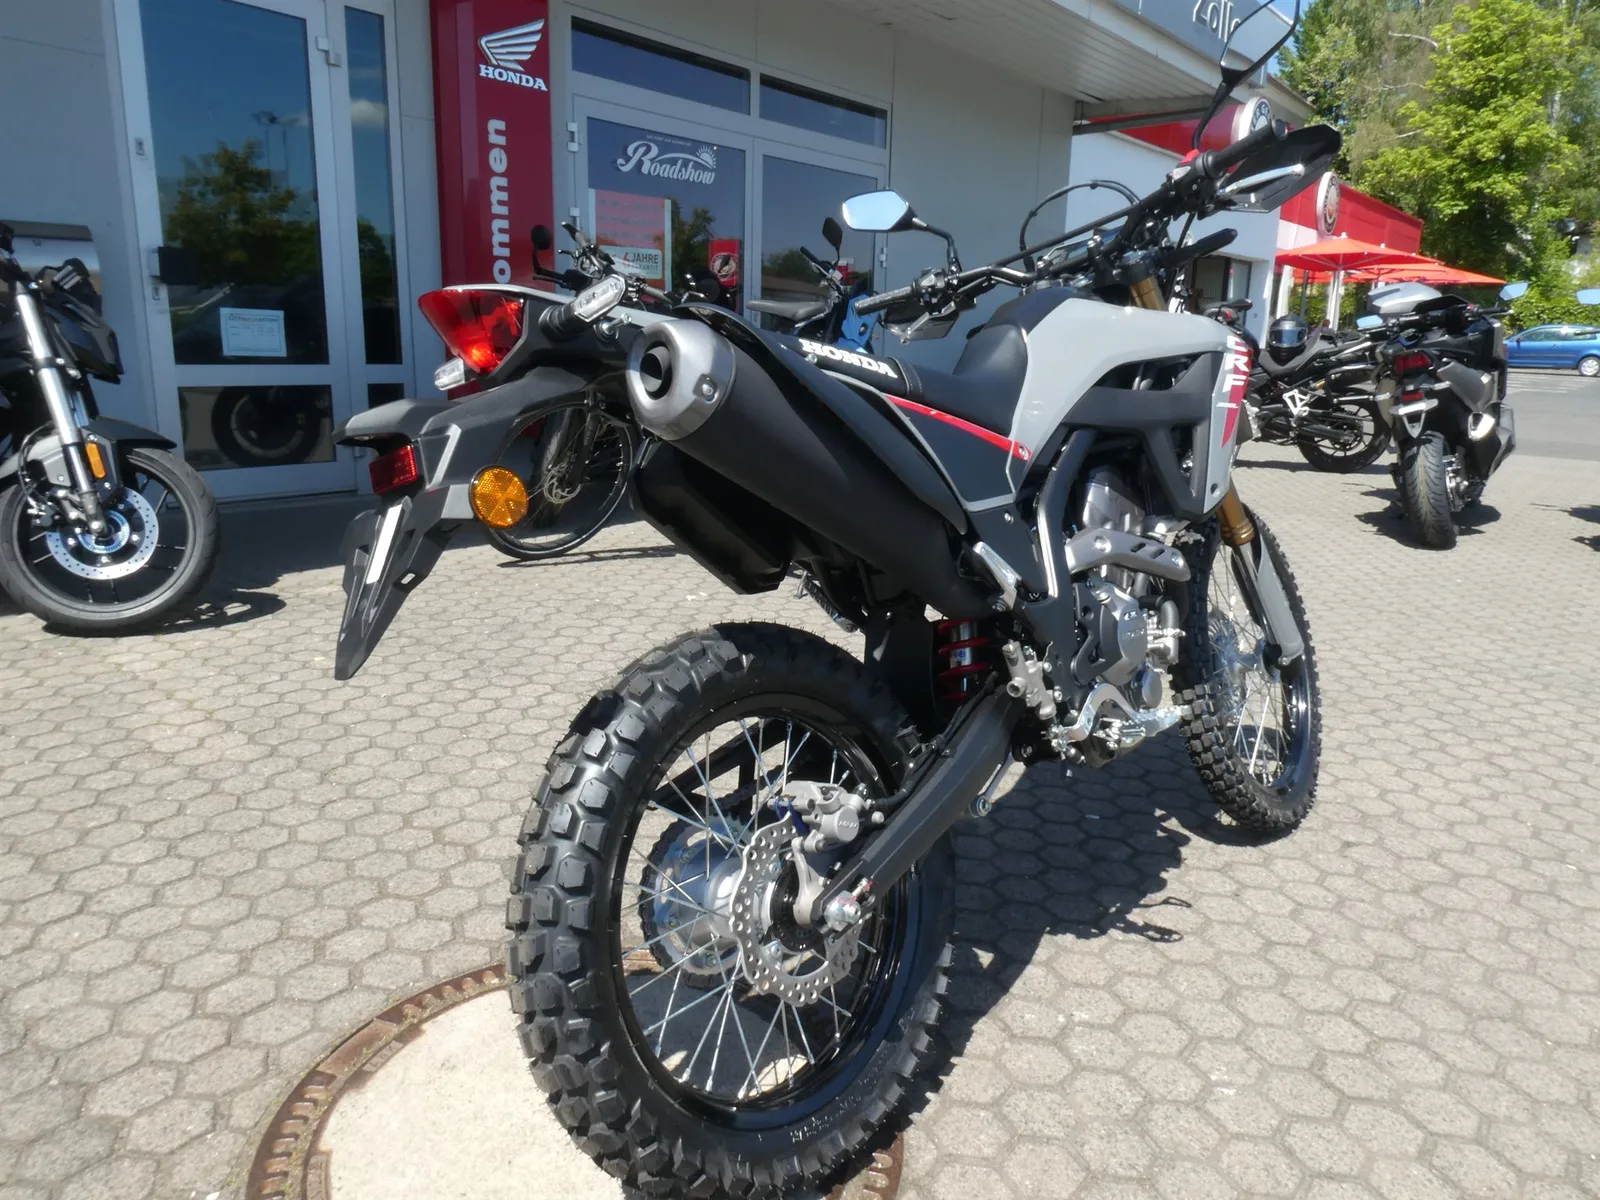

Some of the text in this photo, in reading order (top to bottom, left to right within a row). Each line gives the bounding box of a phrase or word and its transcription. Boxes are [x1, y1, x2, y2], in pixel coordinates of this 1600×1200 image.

[478, 63, 549, 92] HONDA
[616, 140, 716, 185] Roadshow
[487, 118, 512, 285] ommen
[631, 251, 660, 265] JAHRE
[798, 338, 898, 379] HONDA
